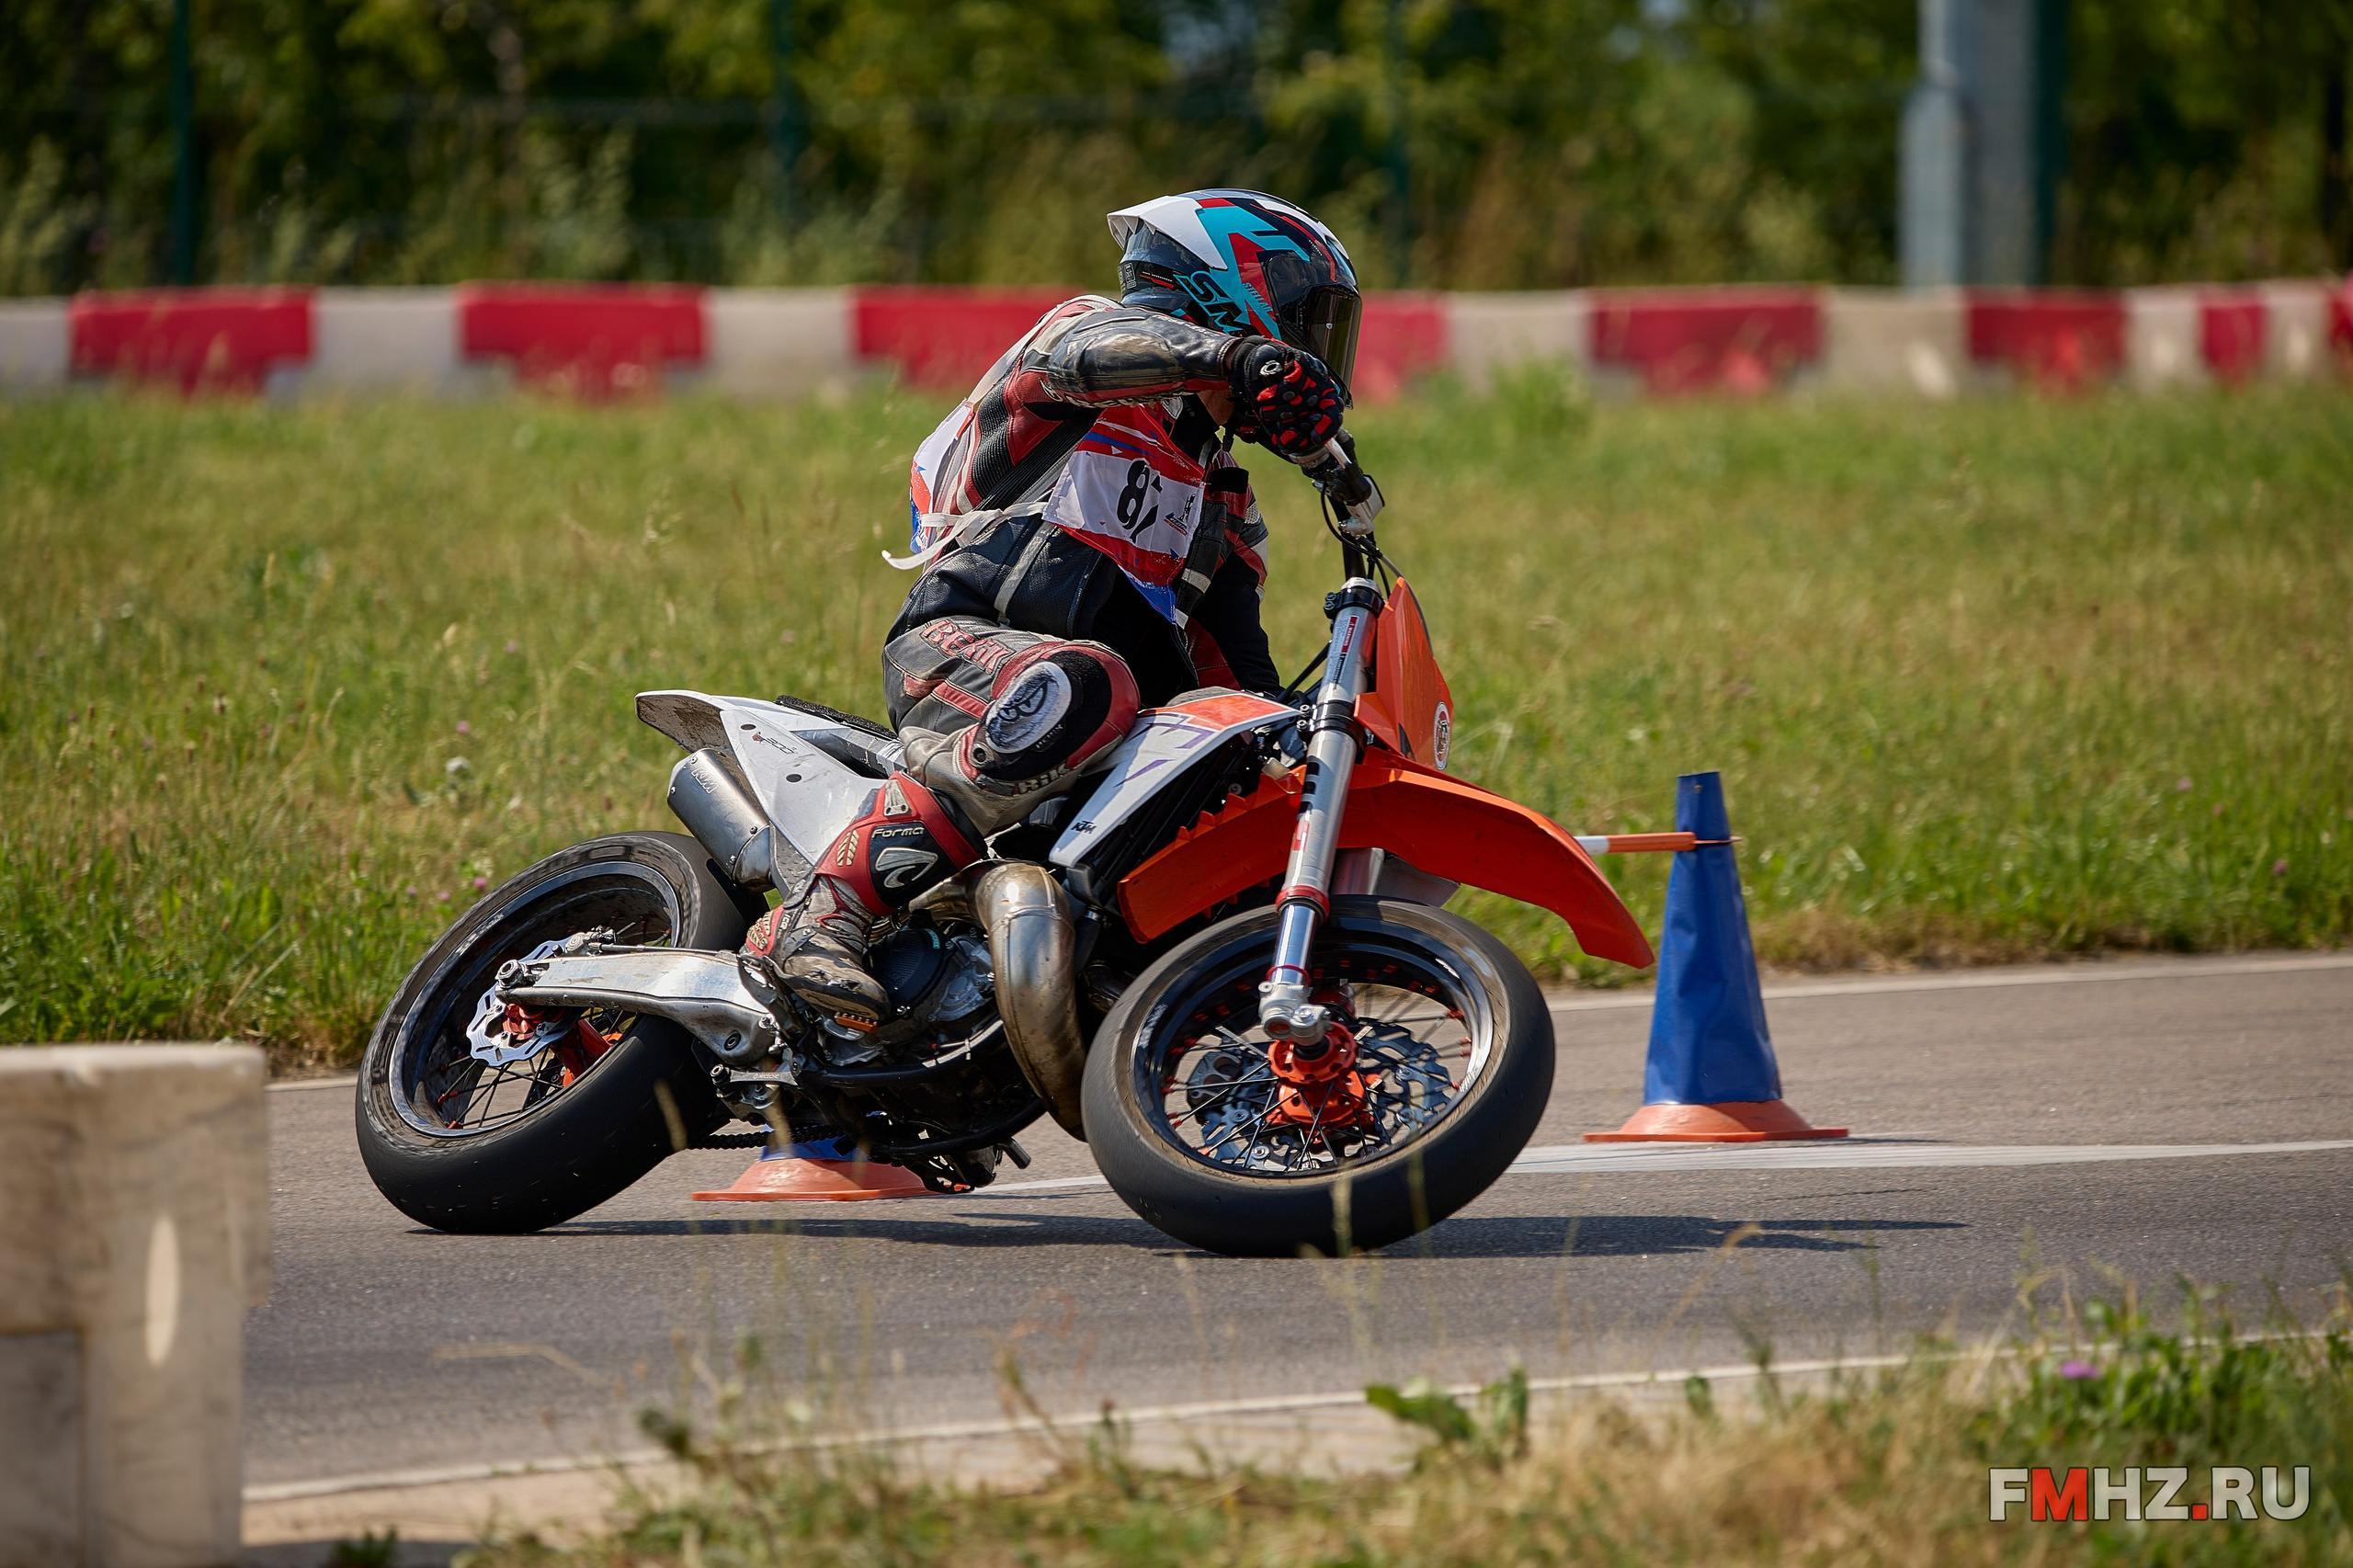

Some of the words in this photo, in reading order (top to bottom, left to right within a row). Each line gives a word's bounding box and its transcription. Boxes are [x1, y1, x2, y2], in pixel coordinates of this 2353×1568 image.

[1242, 281, 1274, 313] STELLAR
[690, 768, 720, 795] KTM
[1070, 820, 1097, 835] KTM
